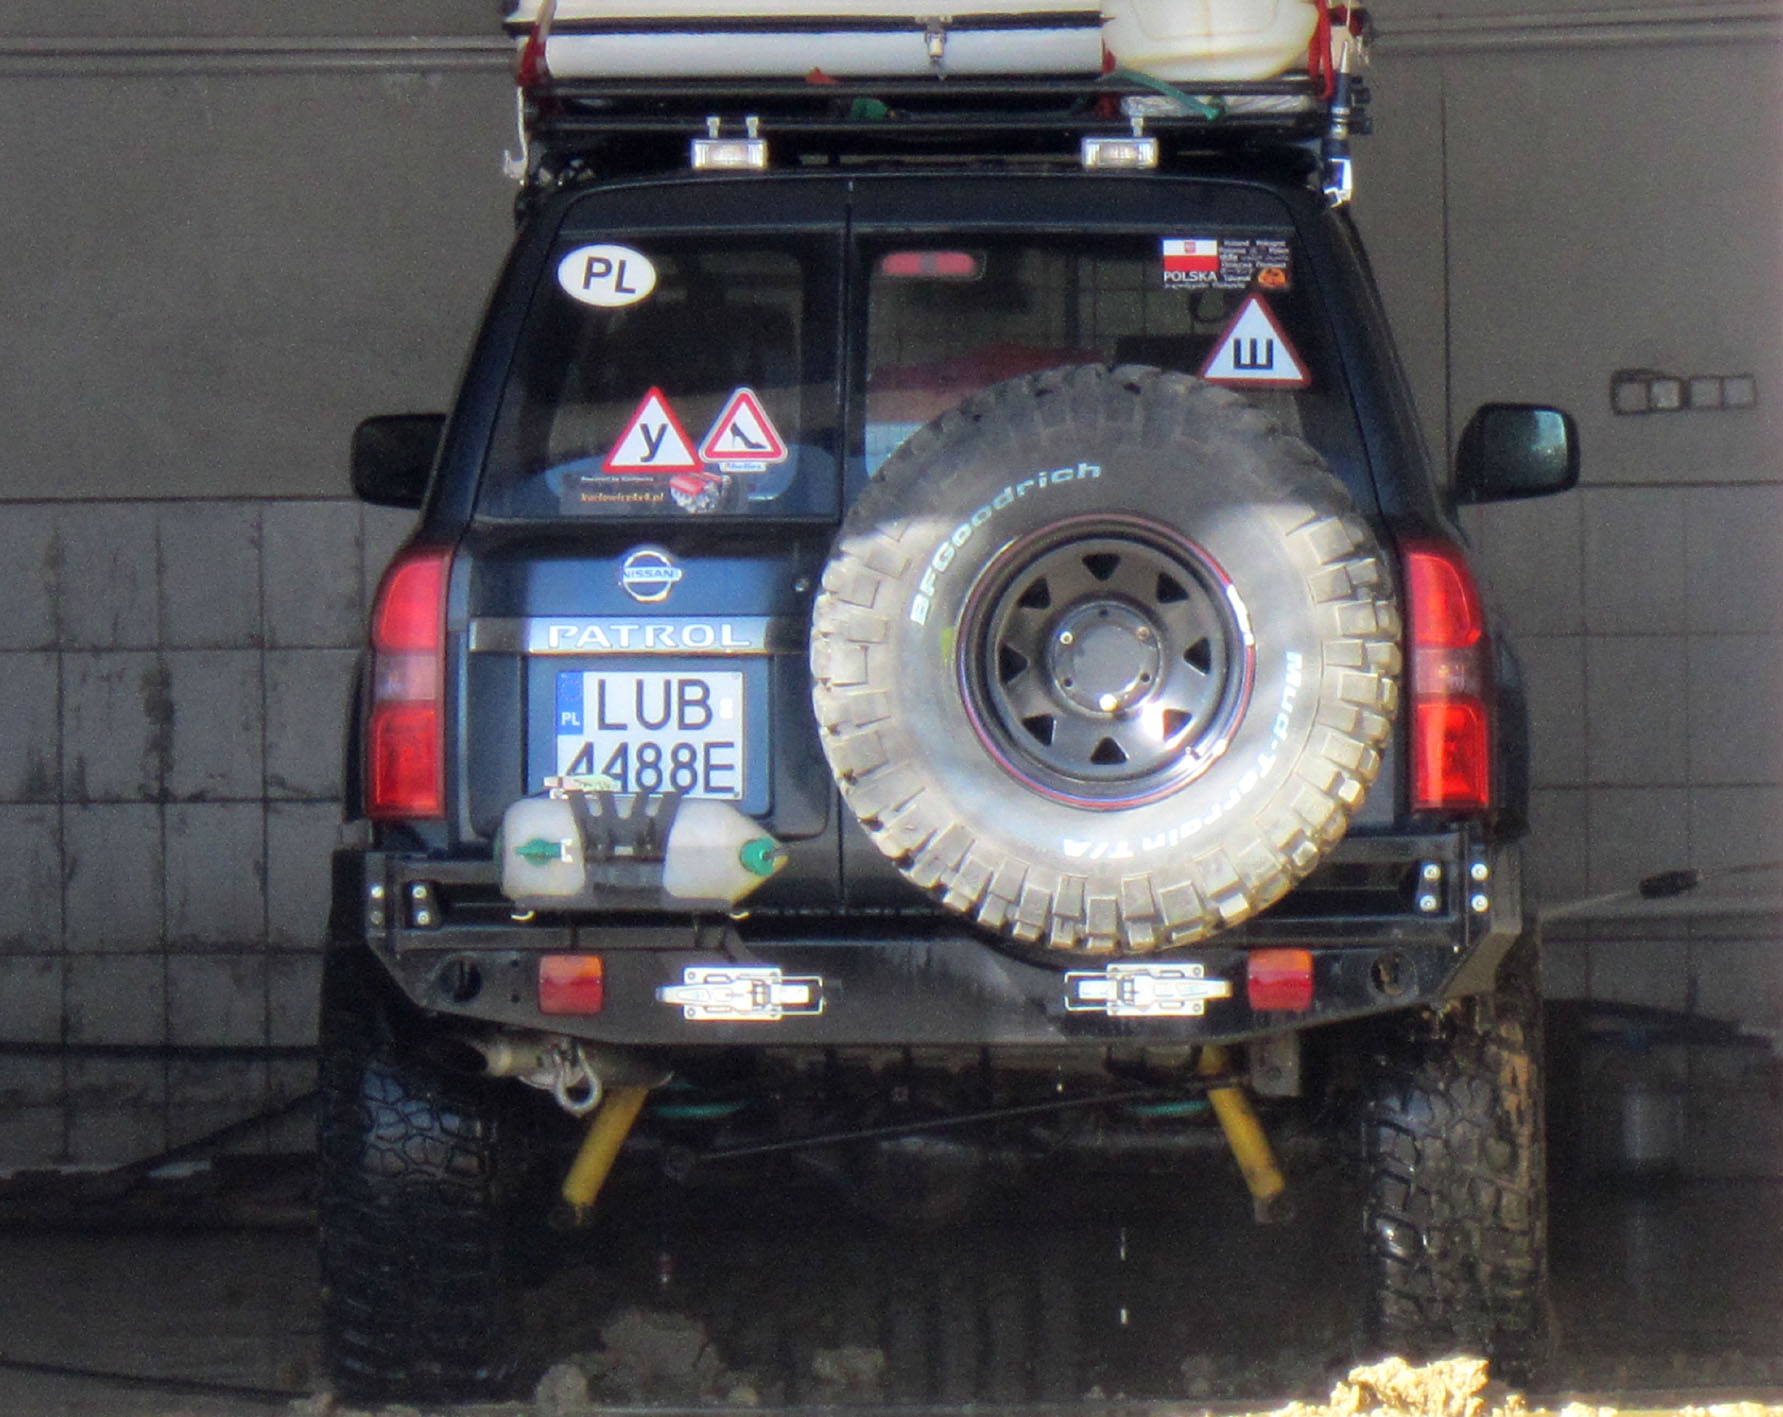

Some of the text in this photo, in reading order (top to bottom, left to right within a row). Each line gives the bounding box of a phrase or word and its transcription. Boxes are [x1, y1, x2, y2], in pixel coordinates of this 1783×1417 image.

[582, 255, 636, 294] PL
[1162, 271, 1218, 282] POLSKA
[910, 462, 1102, 626] BFGoodrich
[622, 569, 676, 580] NISSAN
[548, 623, 751, 649] PATROL
[597, 678, 714, 731] LUB
[560, 711, 581, 727] PL
[564, 740, 735, 794] 4488E
[1063, 840, 1135, 859] T/A
